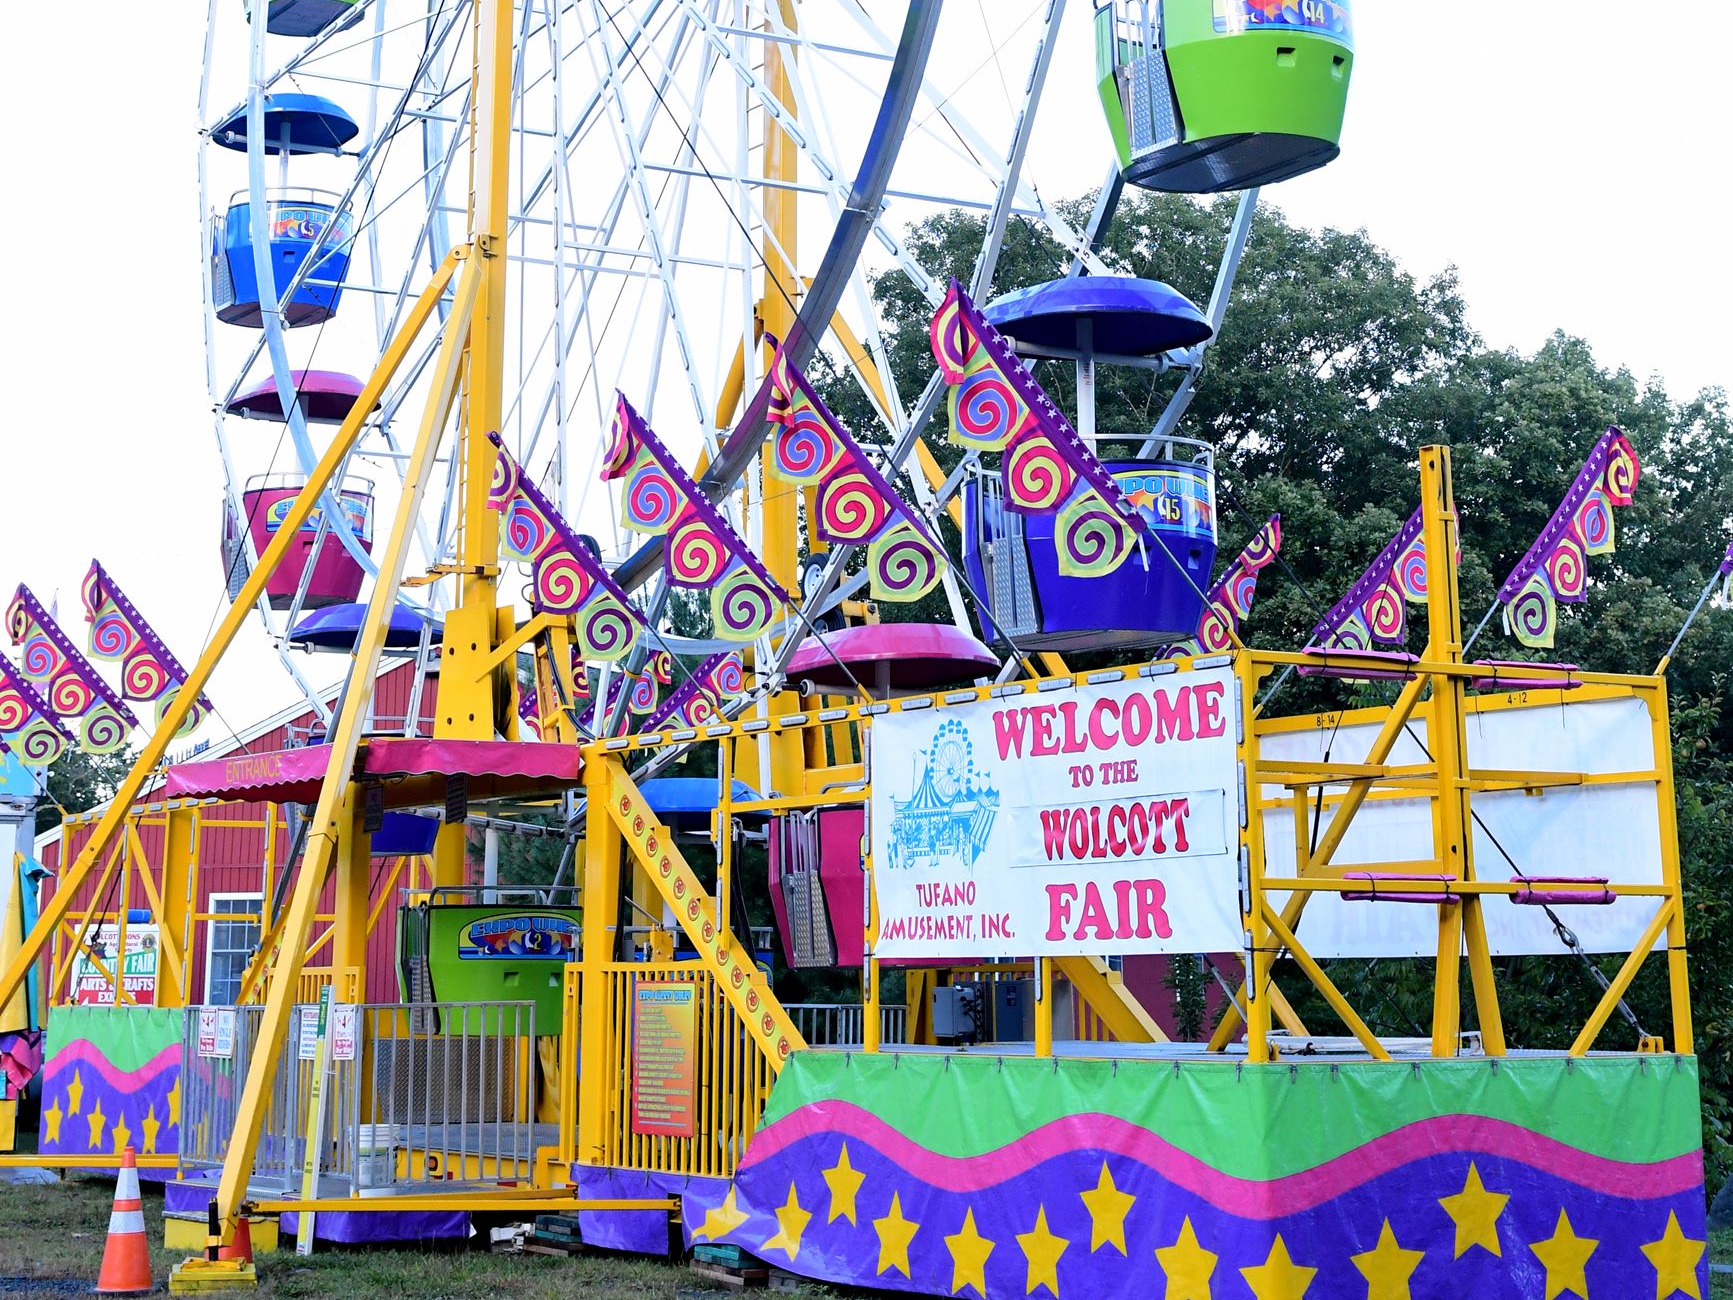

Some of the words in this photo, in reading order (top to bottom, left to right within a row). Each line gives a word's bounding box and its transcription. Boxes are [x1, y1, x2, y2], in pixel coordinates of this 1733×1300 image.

[1309, 1, 1325, 23] 14
[1118, 477, 1163, 495] PO
[1165, 498, 1180, 521] 15
[993, 681, 1226, 761] WELCOME
[226, 754, 282, 783] ENTRANCE
[1069, 765, 1093, 788] TO
[1099, 760, 1139, 785] THE
[1040, 798, 1189, 860] WOLCOTT
[915, 881, 976, 907] TUFANO
[1045, 879, 1173, 942] FAIR
[471, 918, 531, 938] EXPO
[881, 915, 977, 941] AMUSEMENT,
[981, 913, 1016, 939] INC.
[534, 933, 541, 949] 2
[131, 953, 155, 973] FAIR
[80, 977, 107, 991] ARTS
[119, 977, 154, 991] RAFTS
